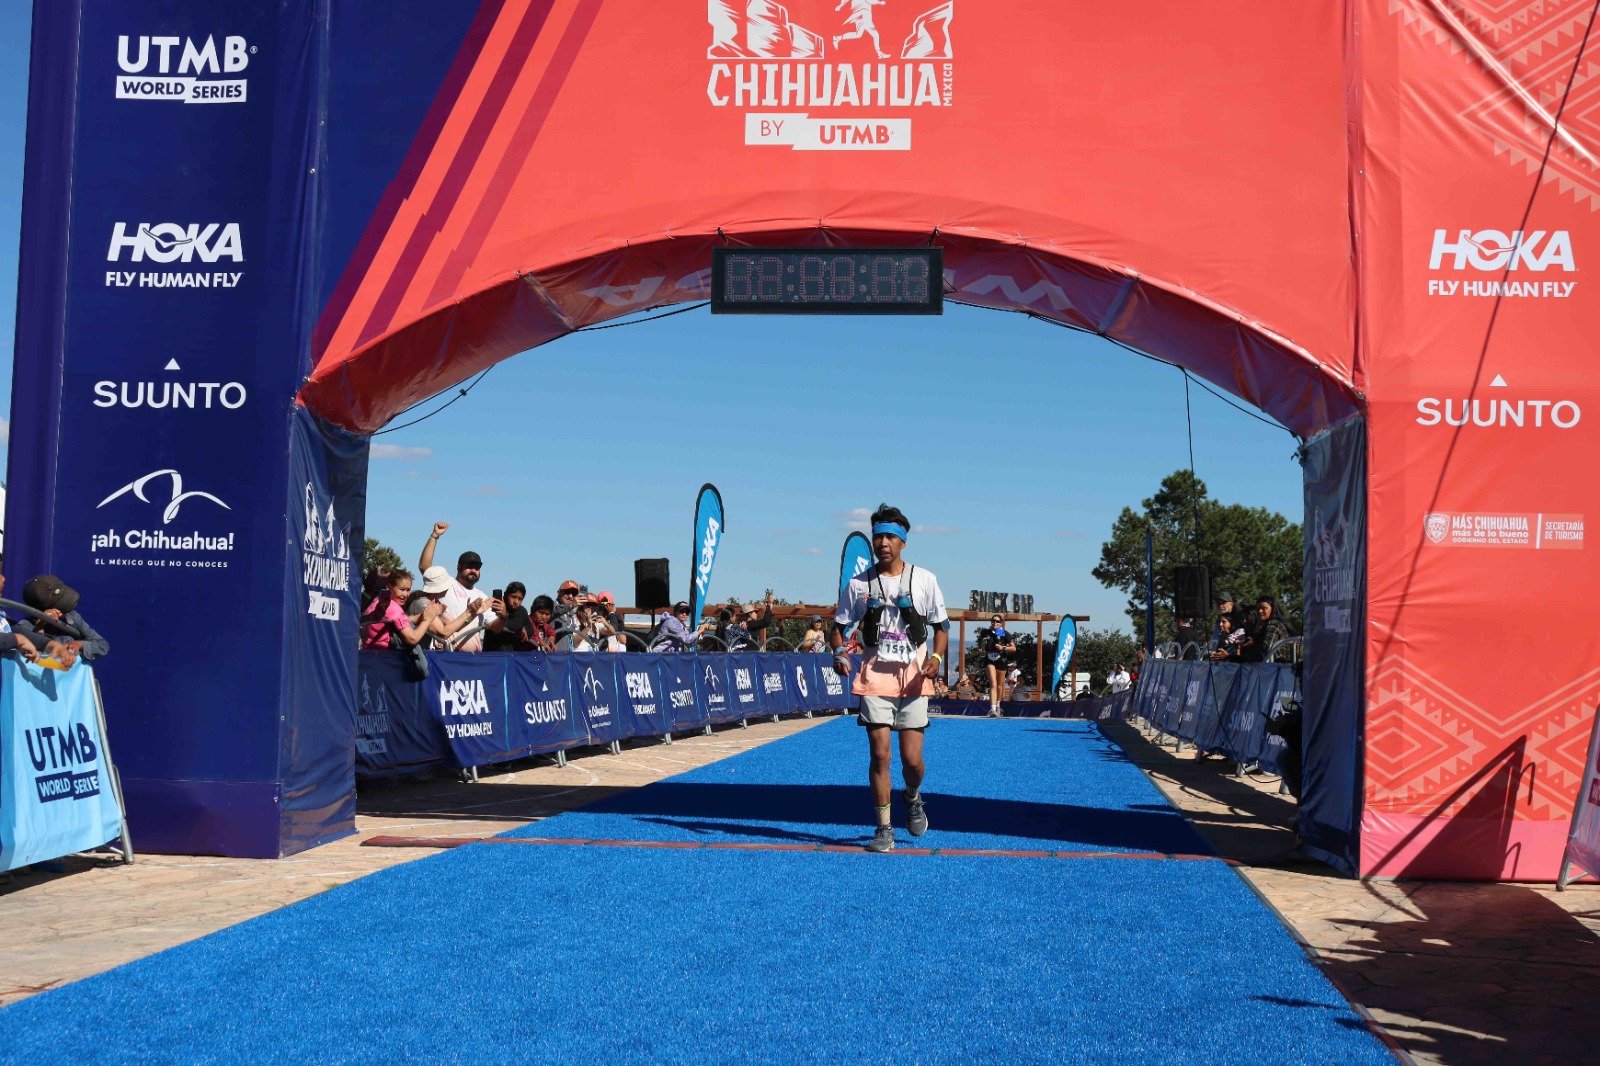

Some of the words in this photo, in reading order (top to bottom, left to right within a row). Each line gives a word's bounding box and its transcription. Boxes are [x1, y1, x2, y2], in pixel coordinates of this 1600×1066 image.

[122, 80, 186, 96] WORLD
[191, 84, 243, 99] SERIES
[706, 62, 942, 107] CHIHUAHUA
[942, 62, 954, 107] MEXICO
[759, 120, 785, 137] BY
[107, 221, 244, 264] HOKA
[1428, 228, 1576, 272] HOKA
[105, 271, 137, 288] FLY
[139, 271, 210, 288] HUMAN
[212, 272, 243, 288] FLY
[1428, 279, 1459, 297] FLY
[1463, 280, 1540, 298] HUMAN
[1543, 280, 1575, 298] FLY
[92, 380, 247, 410] SUUNTO
[1415, 397, 1581, 429] SUUNTO
[1452, 513, 1473, 530] MÁS
[1475, 516, 1529, 531] CHIHUAHUA
[1452, 529, 1472, 537] más
[1474, 529, 1486, 537] de
[1488, 529, 1497, 538] lo
[1499, 530, 1529, 538] bueno
[1545, 520, 1584, 531] SECRETARÍA
[91, 528, 121, 552] ¡ah
[124, 529, 235, 551] Chihuahua!
[1544, 531, 1553, 540] DE
[1555, 531, 1584, 541] TURISMO
[94, 558, 106, 566] EL
[109, 558, 144, 566] MÉXICO
[147, 559, 166, 567] QUE
[169, 559, 182, 567] NO
[185, 560, 228, 568] CONOCES
[696, 516, 720, 595] HOKA
[439, 679, 490, 716] HOKA
[524, 698, 567, 725] SUUNTO
[25, 720, 98, 772] UTMB
[38, 777, 71, 798] WORLD
[73, 775, 100, 795] SERIE
